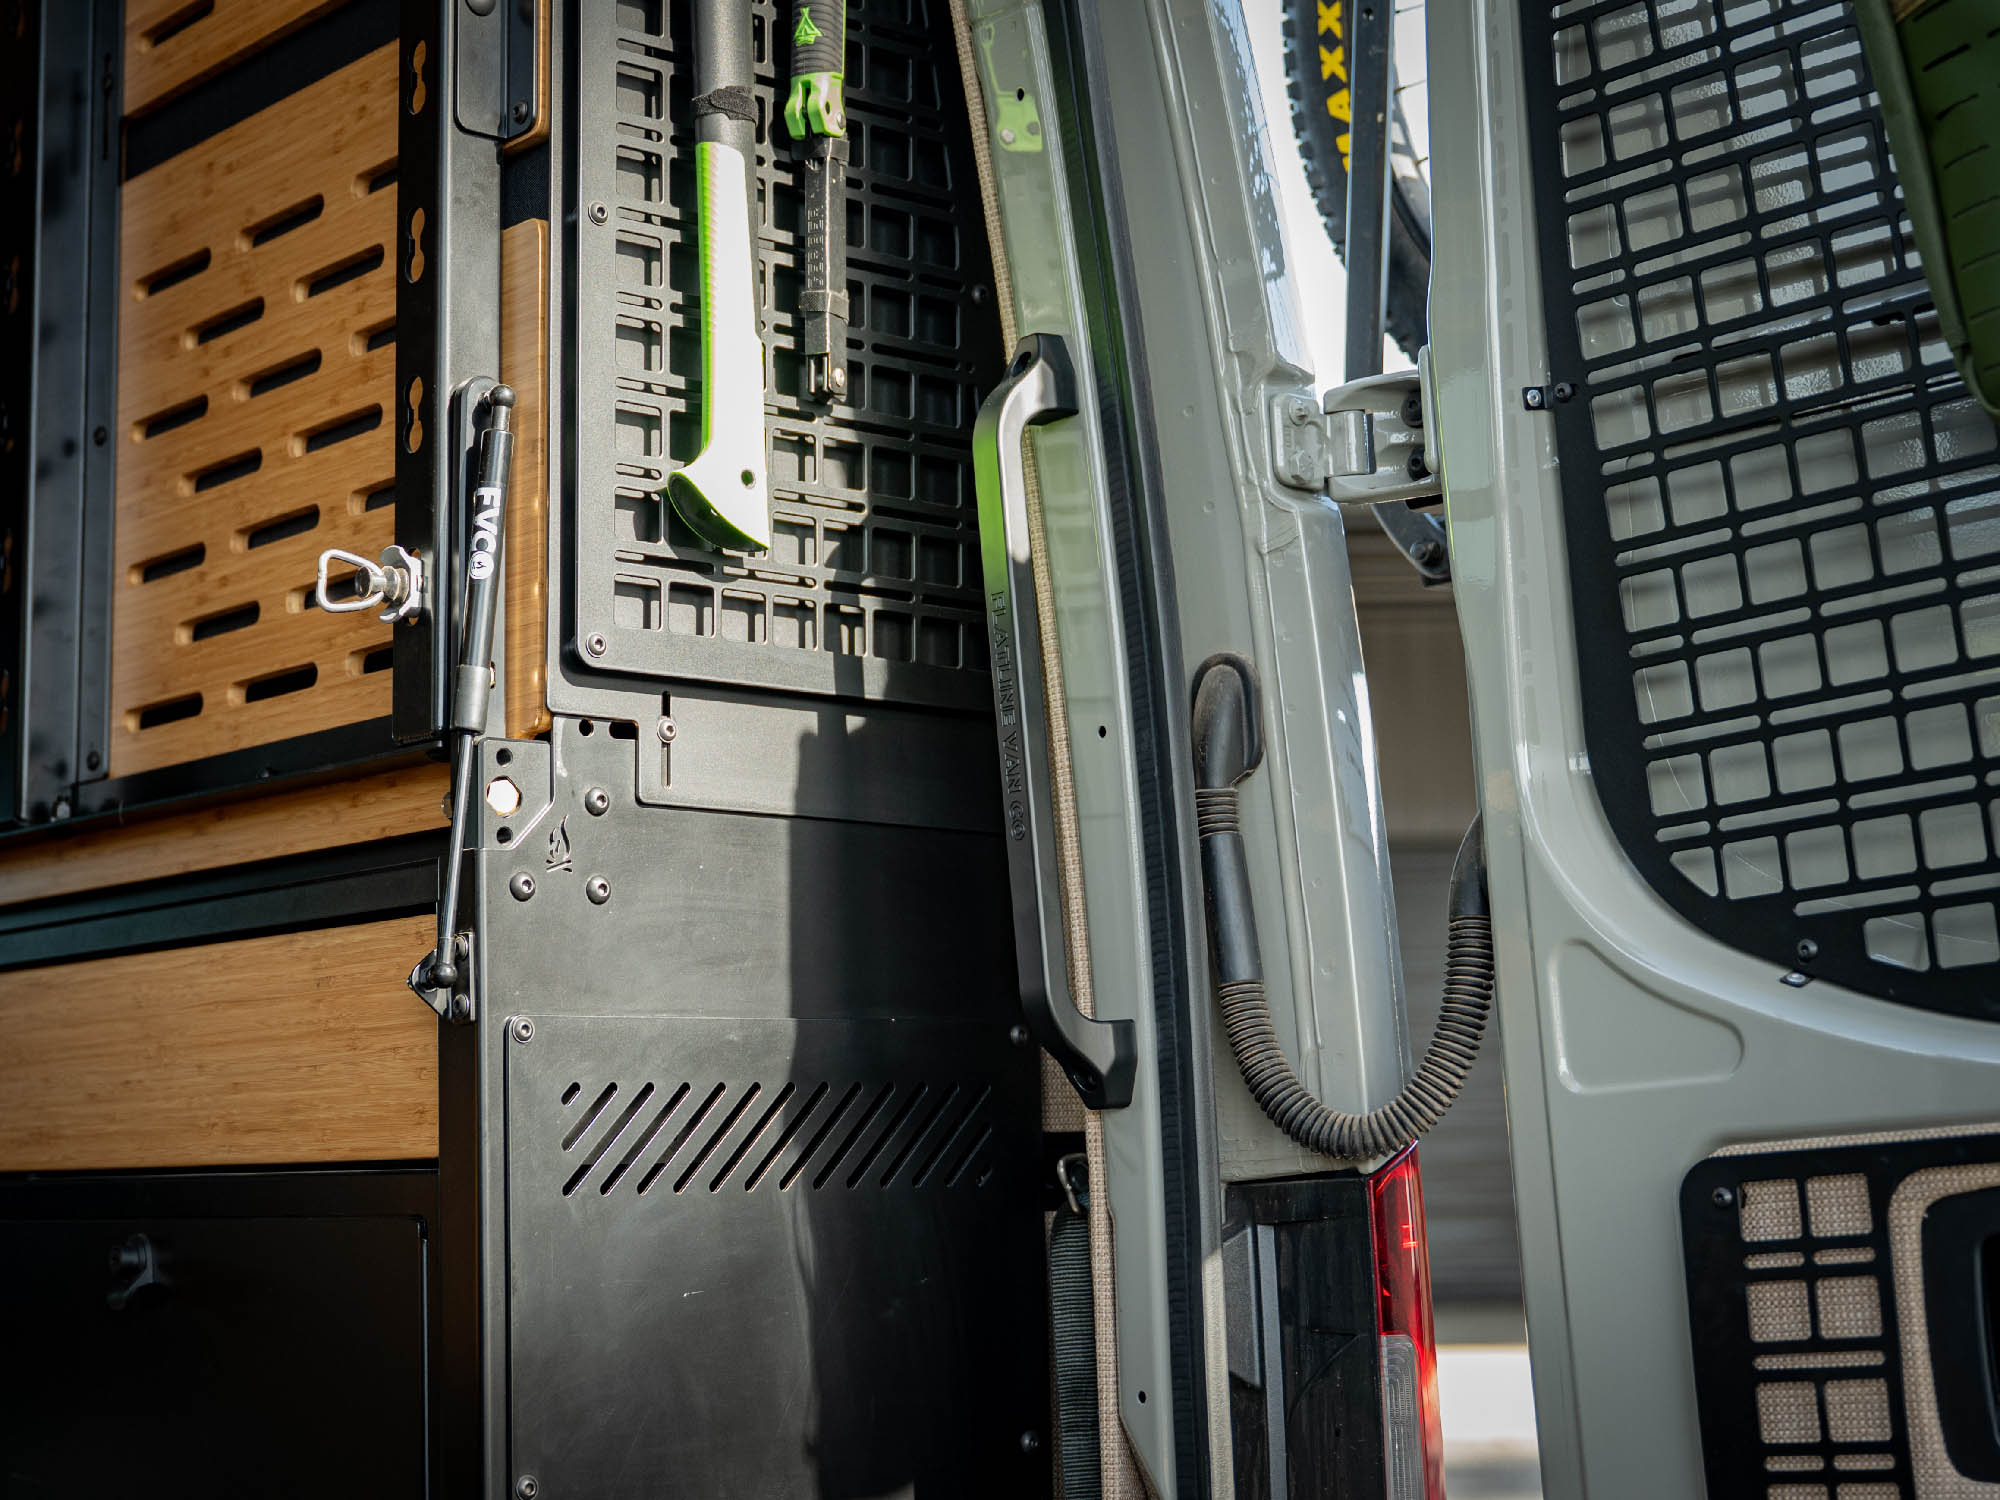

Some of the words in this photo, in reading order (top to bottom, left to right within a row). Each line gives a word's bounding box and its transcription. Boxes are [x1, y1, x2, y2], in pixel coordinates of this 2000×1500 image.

[990, 590, 1017, 726] FLATLINE
[1002, 732, 1022, 795] VAN
[1009, 800, 1027, 842] CO
